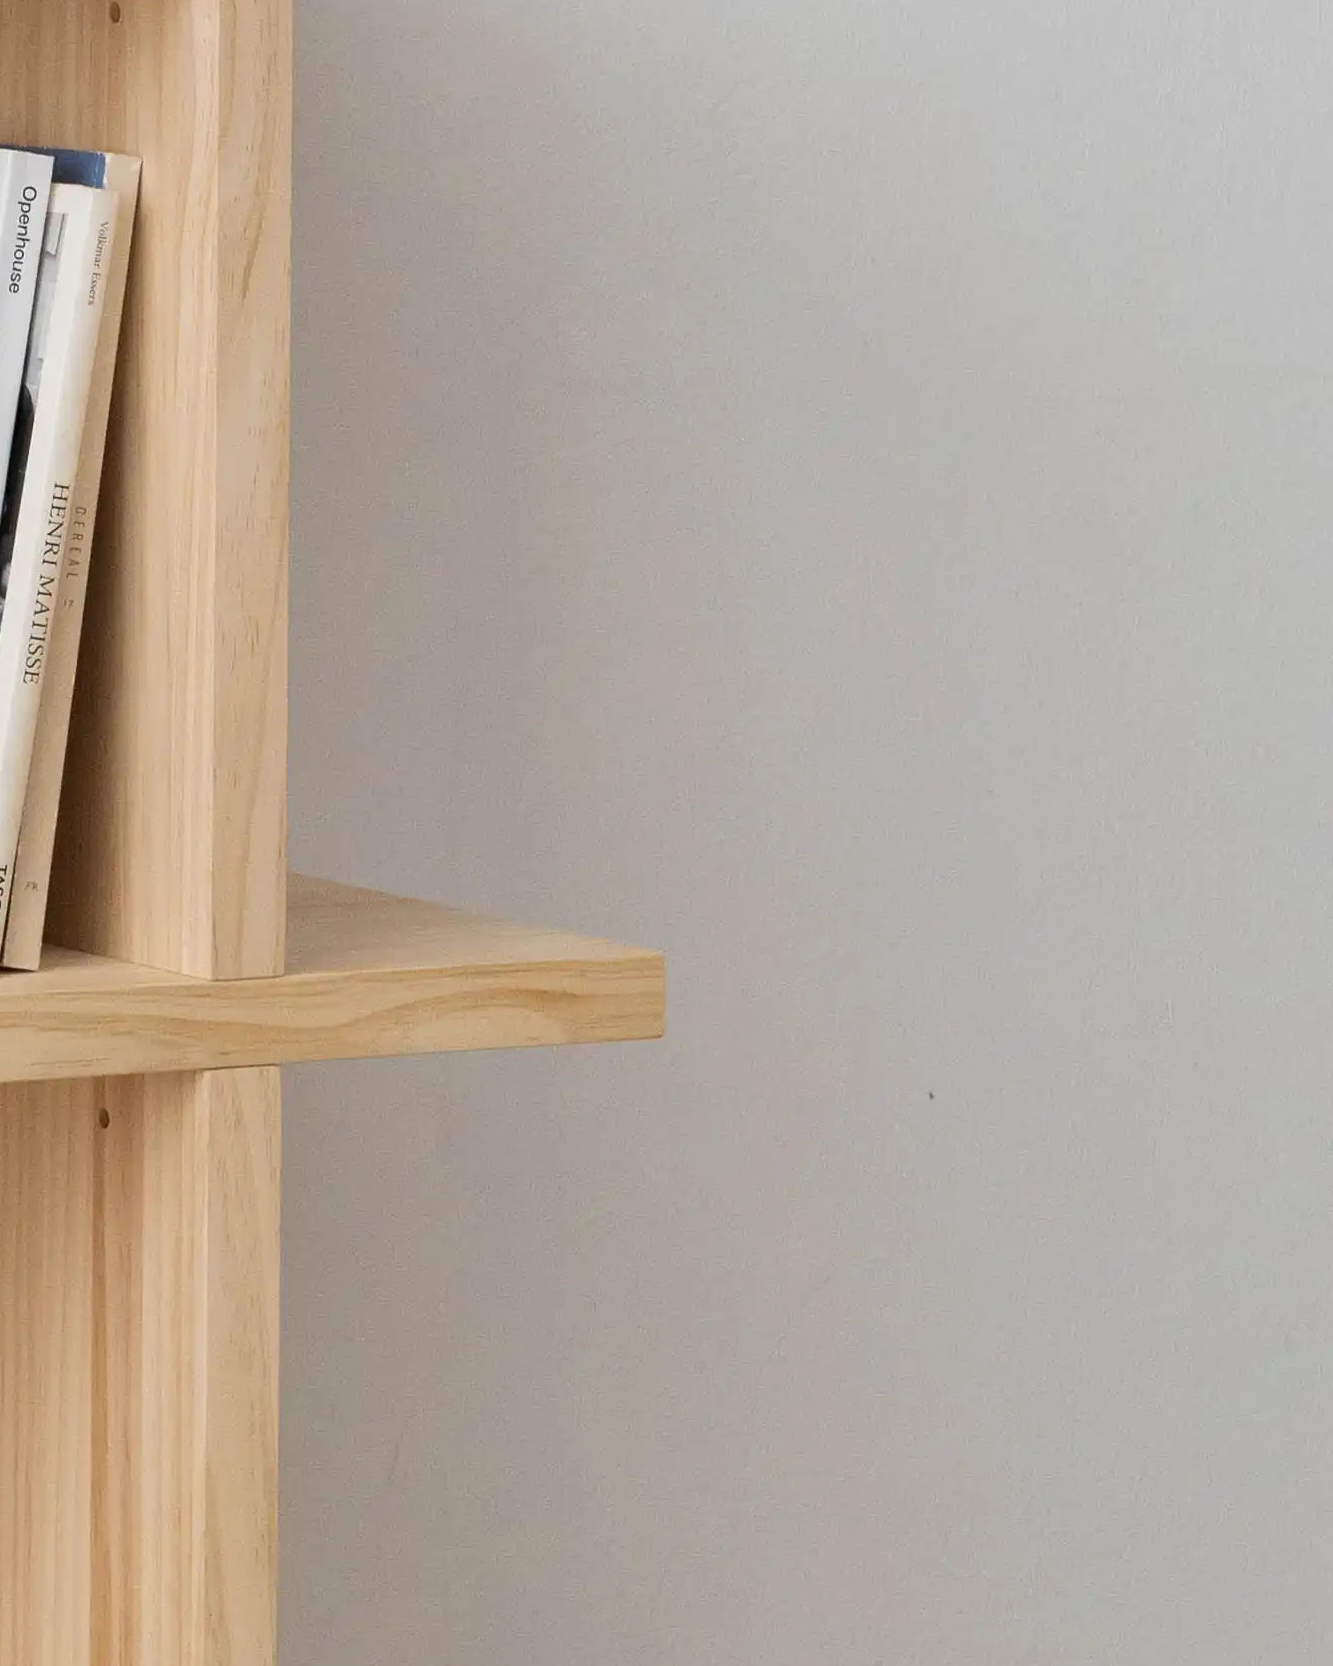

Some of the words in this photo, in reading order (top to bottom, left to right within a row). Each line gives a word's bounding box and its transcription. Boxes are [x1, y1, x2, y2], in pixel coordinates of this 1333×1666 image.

[9, 186, 38, 294] Openhouse
[93, 221, 109, 270] Volkmar
[42, 483, 70, 566] HENRI
[23, 574, 56, 684] MATISSE
